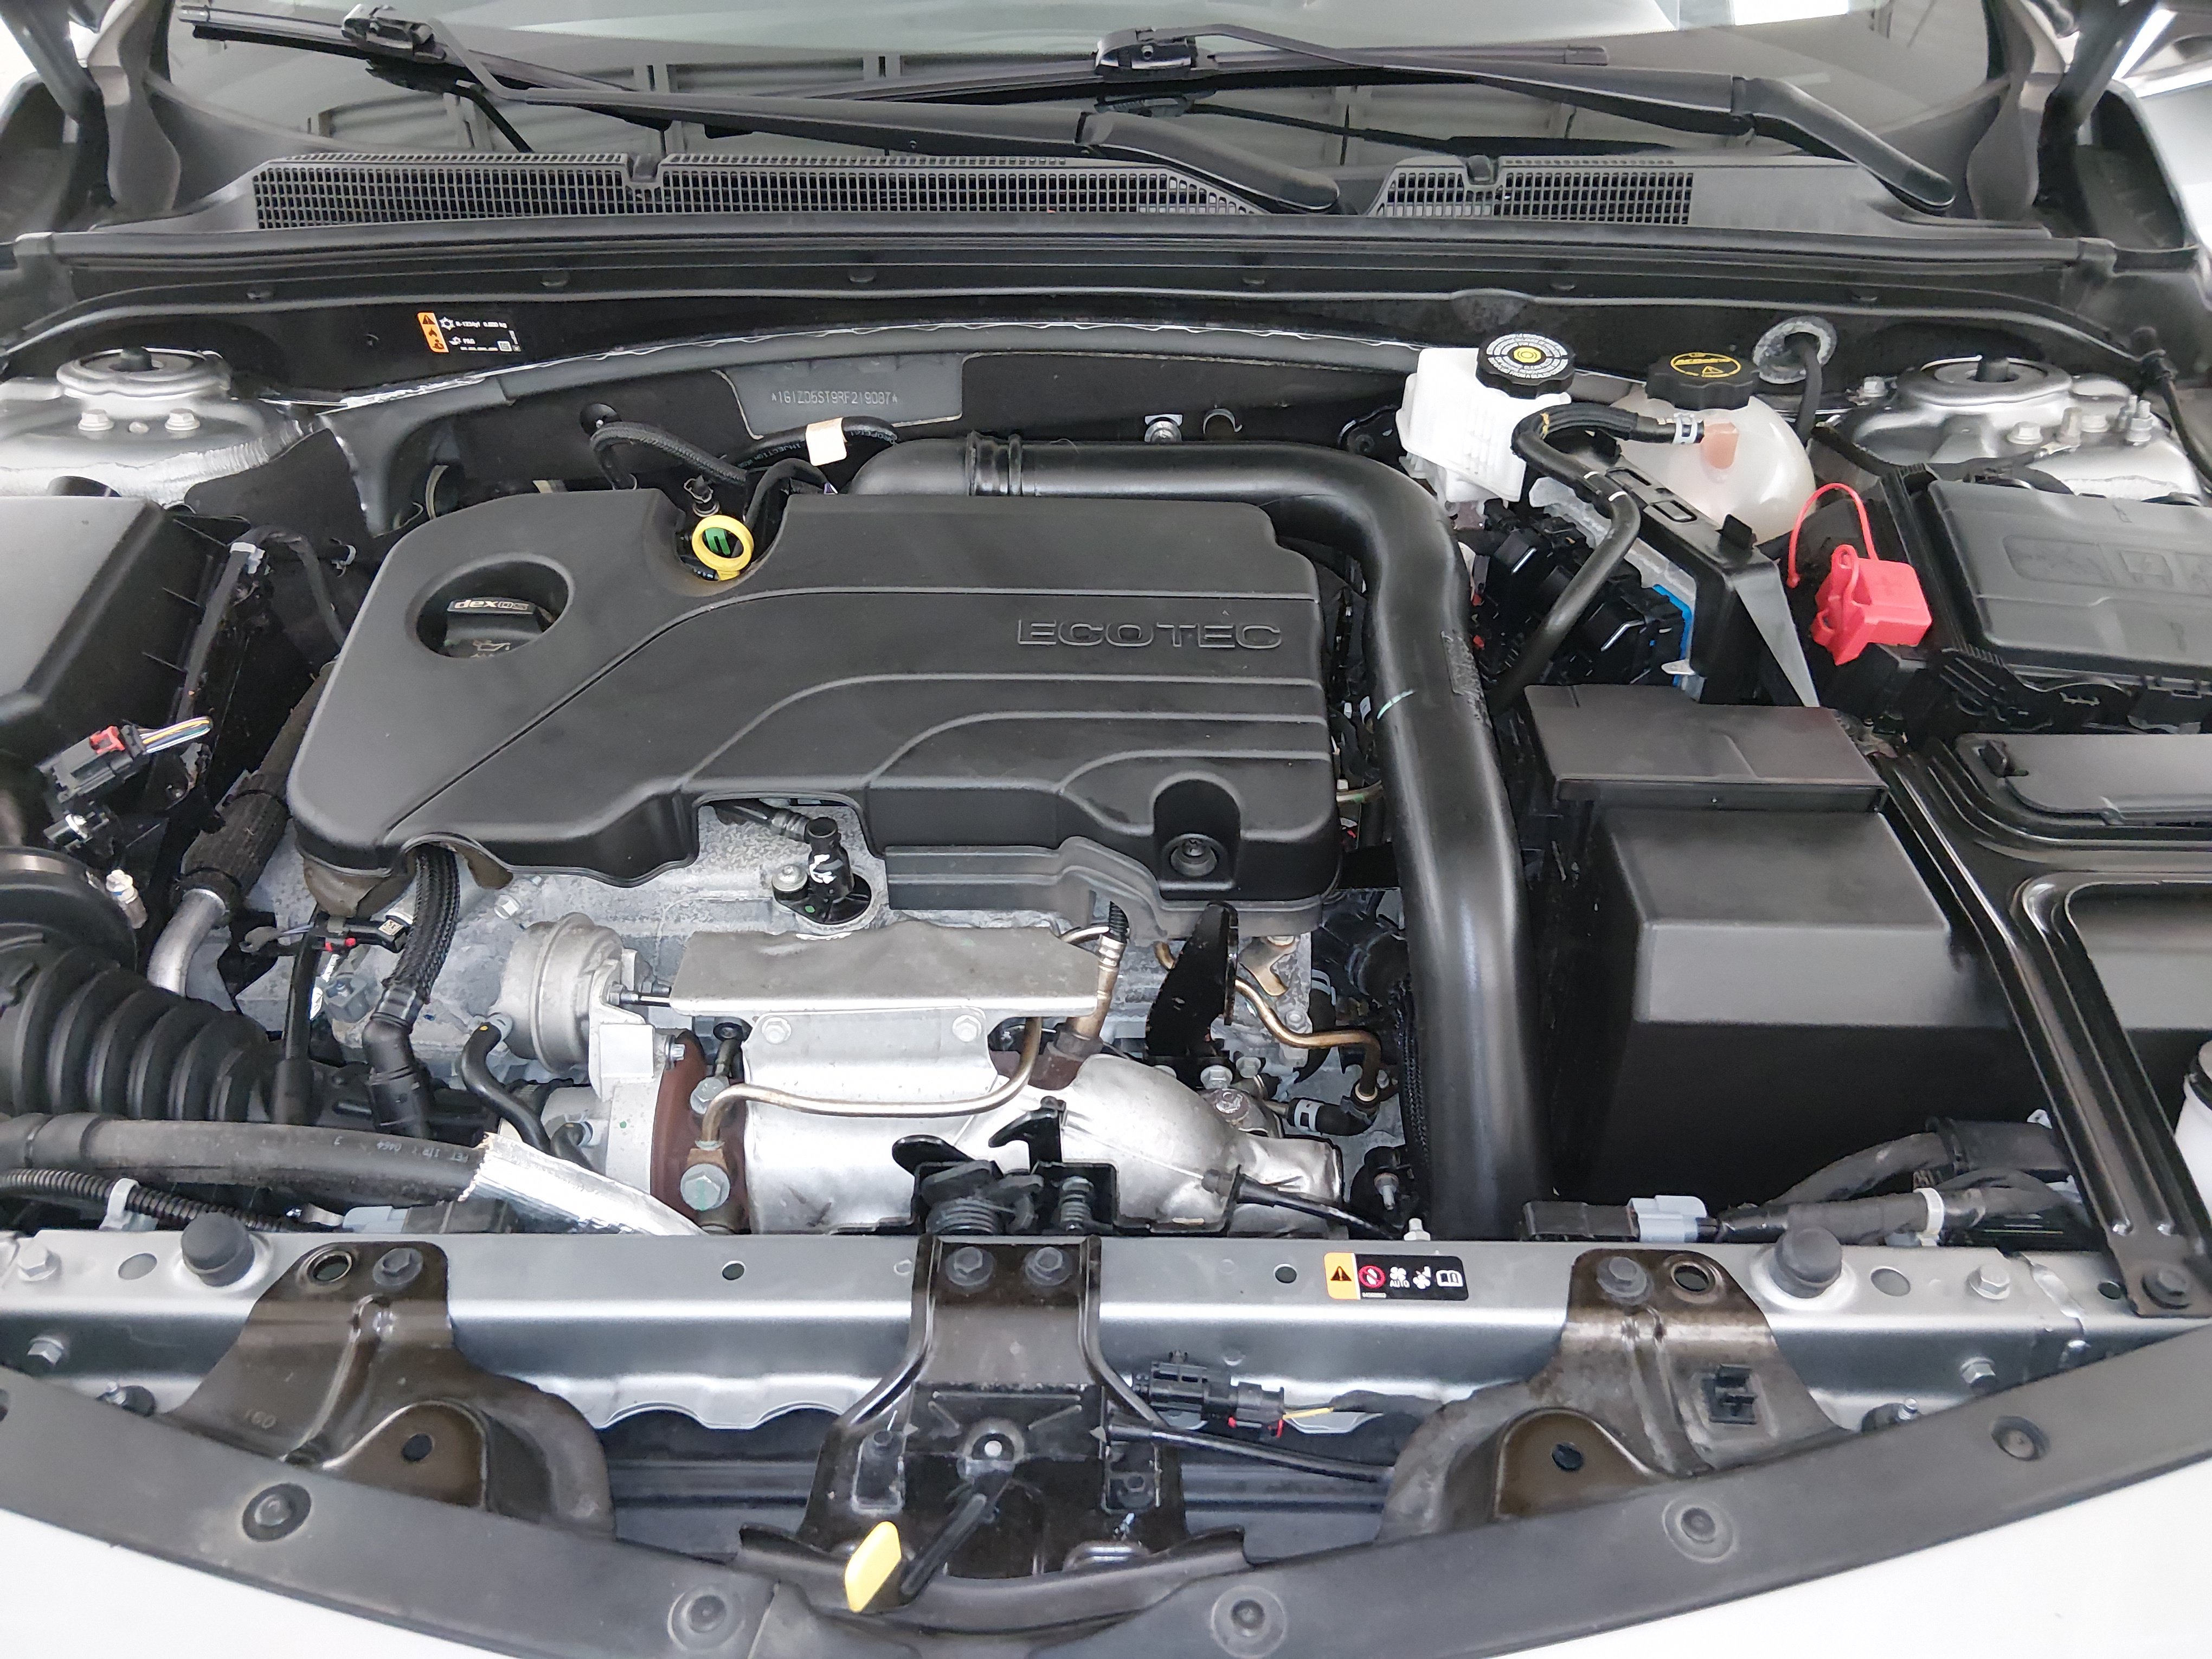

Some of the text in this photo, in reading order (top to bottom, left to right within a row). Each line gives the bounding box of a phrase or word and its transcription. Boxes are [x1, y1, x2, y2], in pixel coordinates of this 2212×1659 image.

[454, 599, 529, 610] dexos
[1017, 618, 1283, 650] ECOTEC
[1390, 1279, 1410, 1288] AUTO
